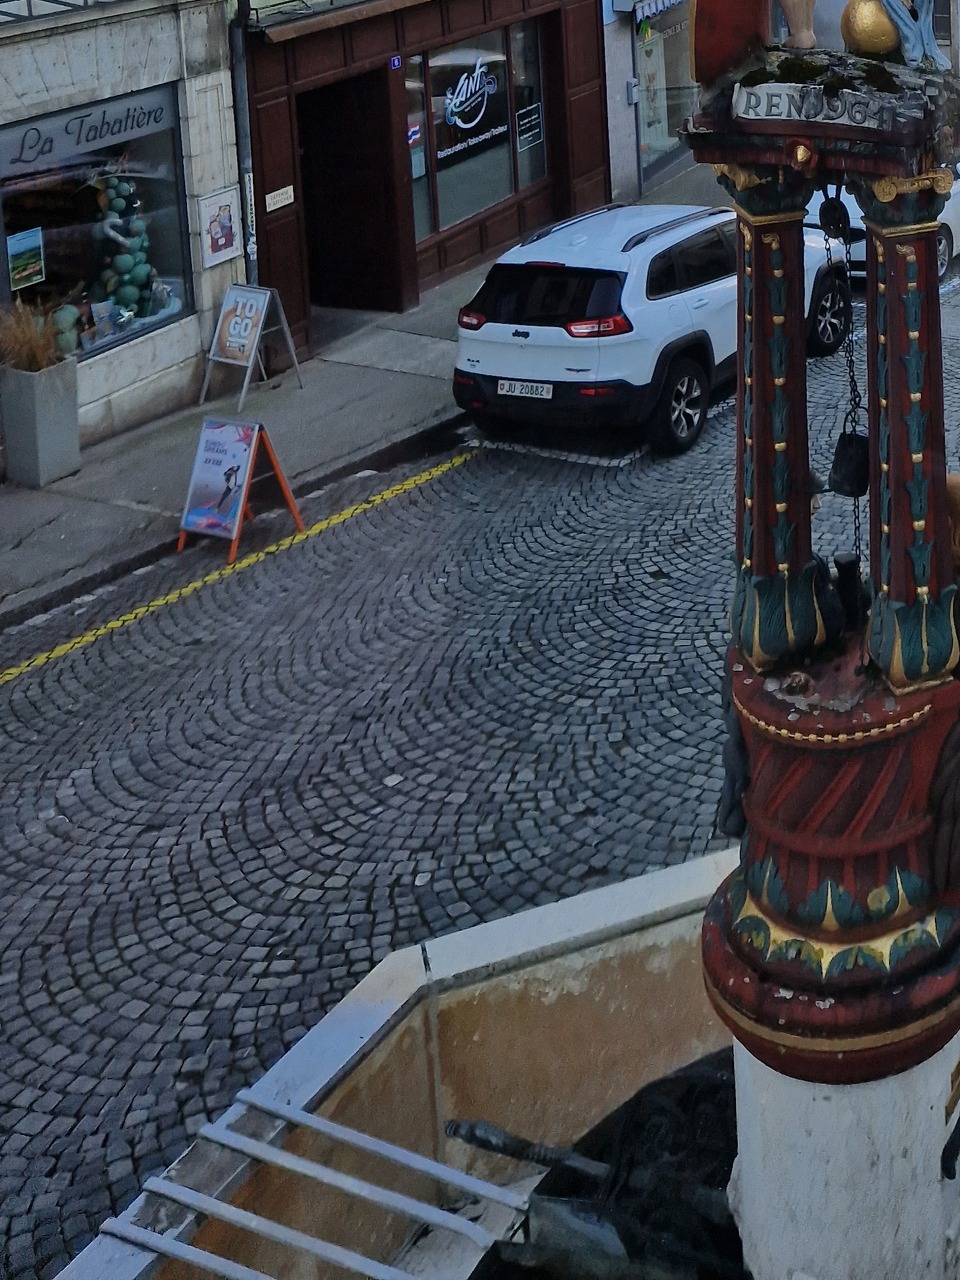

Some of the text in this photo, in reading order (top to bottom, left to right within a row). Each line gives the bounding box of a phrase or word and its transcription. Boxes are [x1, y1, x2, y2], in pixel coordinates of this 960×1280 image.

[10, 106, 164, 165] La Tabatière
[235, 297, 258, 318] TO
[229, 316, 253, 338] GO
[512, 329, 530, 339] Jeep
[505, 384, 545, 397] JU 20882
